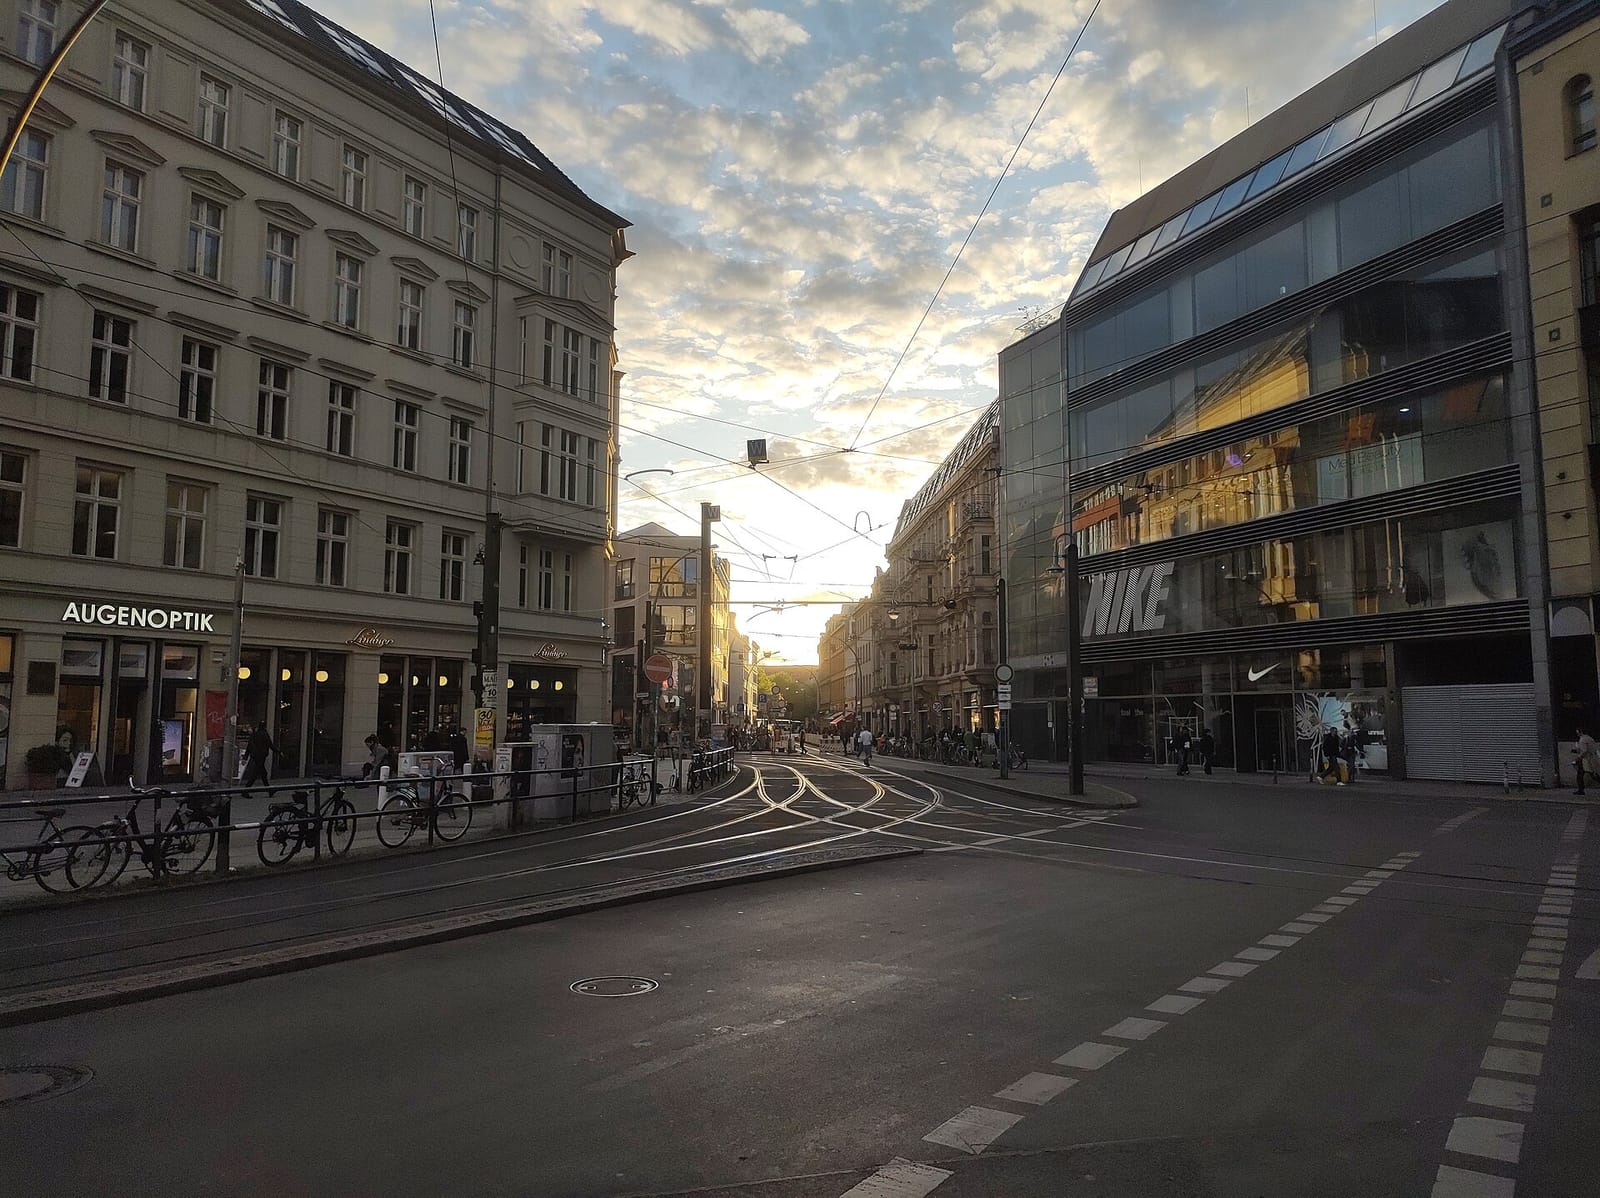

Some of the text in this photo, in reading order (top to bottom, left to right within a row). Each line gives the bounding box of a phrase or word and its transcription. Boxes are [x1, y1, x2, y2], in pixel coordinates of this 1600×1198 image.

[1082, 562, 1175, 637] NIKE
[62, 602, 214, 632] AUGENOPTIK
[479, 710, 492, 719] 30
